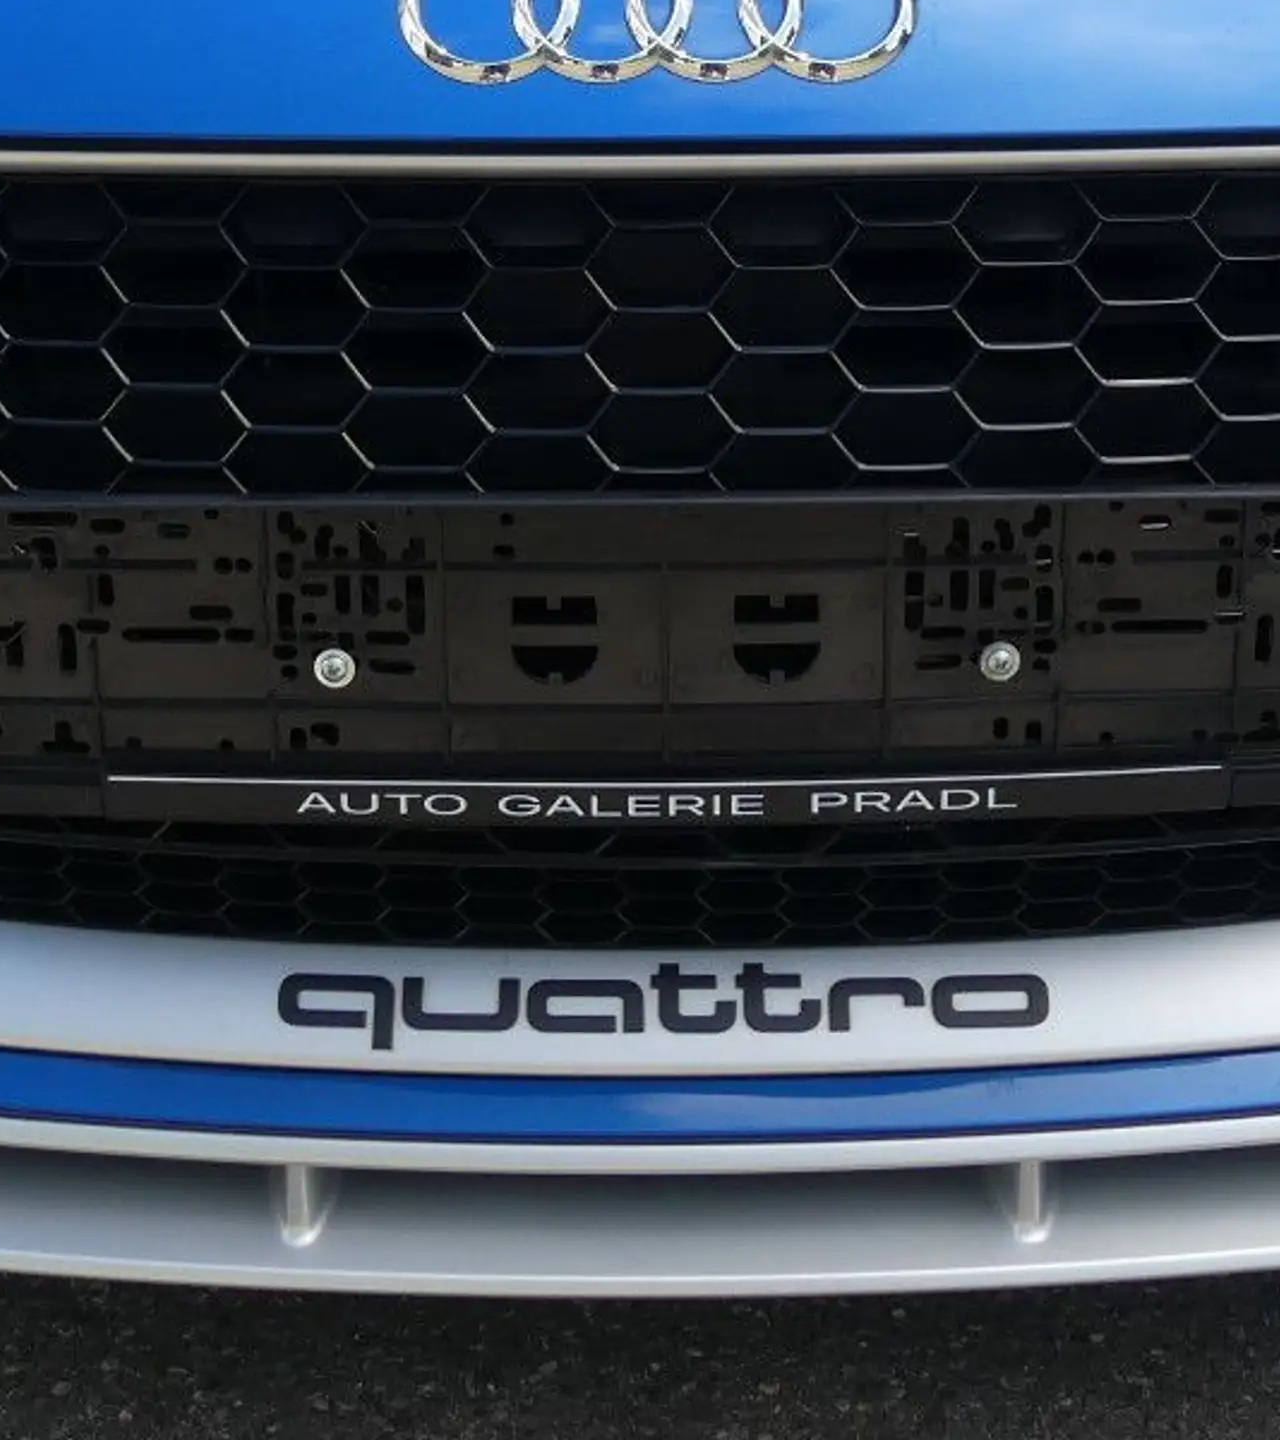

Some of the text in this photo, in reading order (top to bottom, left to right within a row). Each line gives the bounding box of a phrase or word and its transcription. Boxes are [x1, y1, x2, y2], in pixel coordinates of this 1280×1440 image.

[296, 787, 1019, 819] AUTO GALERIE PRADL
[276, 962, 1050, 1051] quattro
